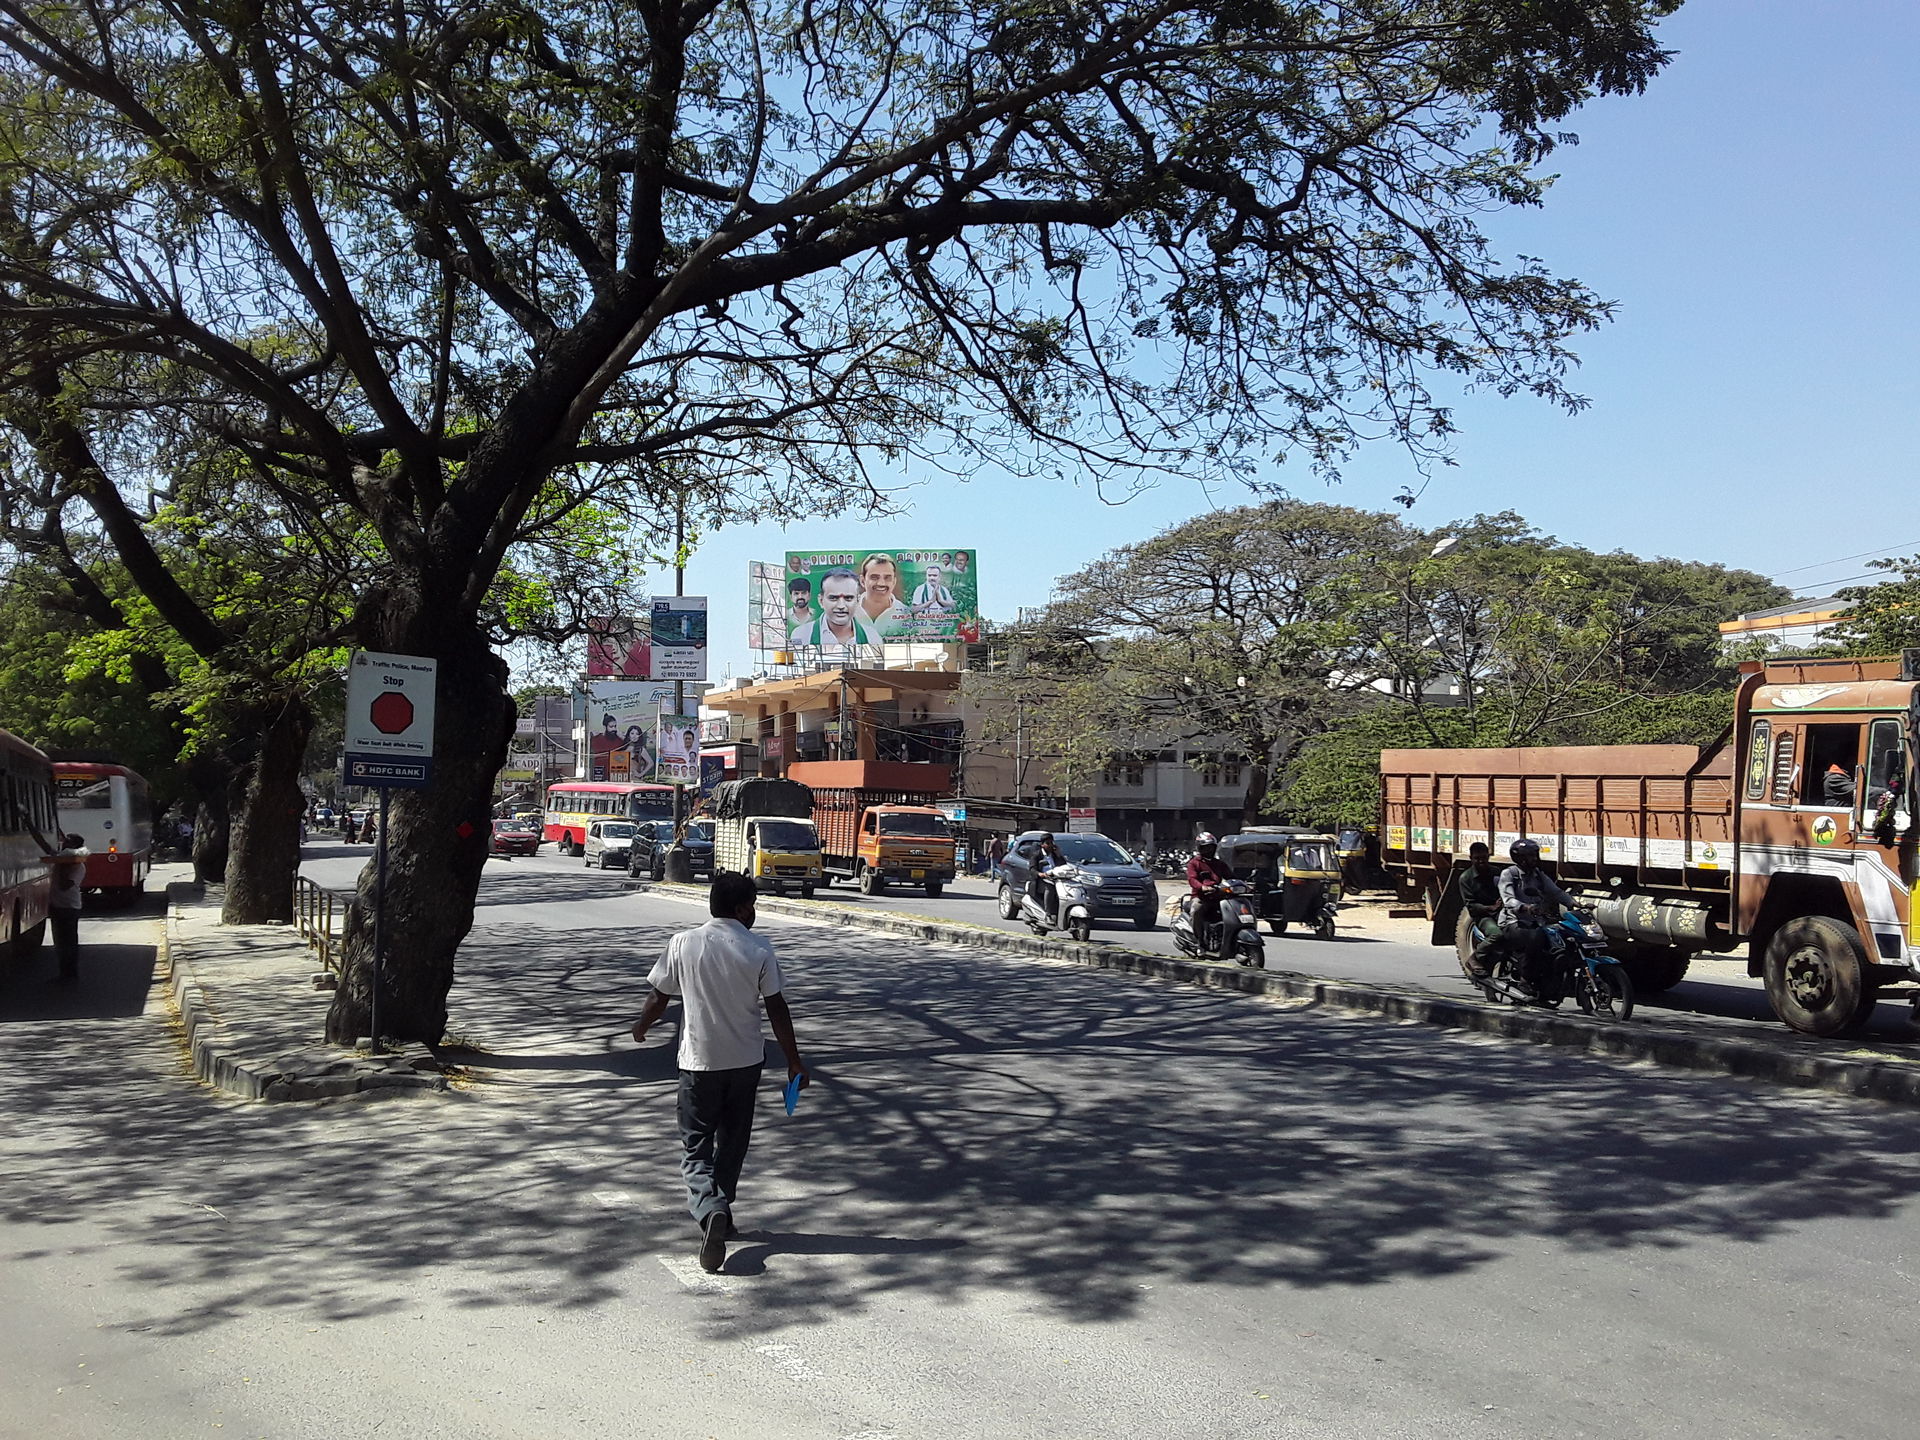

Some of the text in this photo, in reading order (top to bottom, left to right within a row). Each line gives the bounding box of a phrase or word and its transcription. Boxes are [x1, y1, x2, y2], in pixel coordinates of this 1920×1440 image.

[372, 660, 390, 668] Traffic
[383, 675, 404, 687] Stop
[369, 766, 420, 776] HDFC BANK
